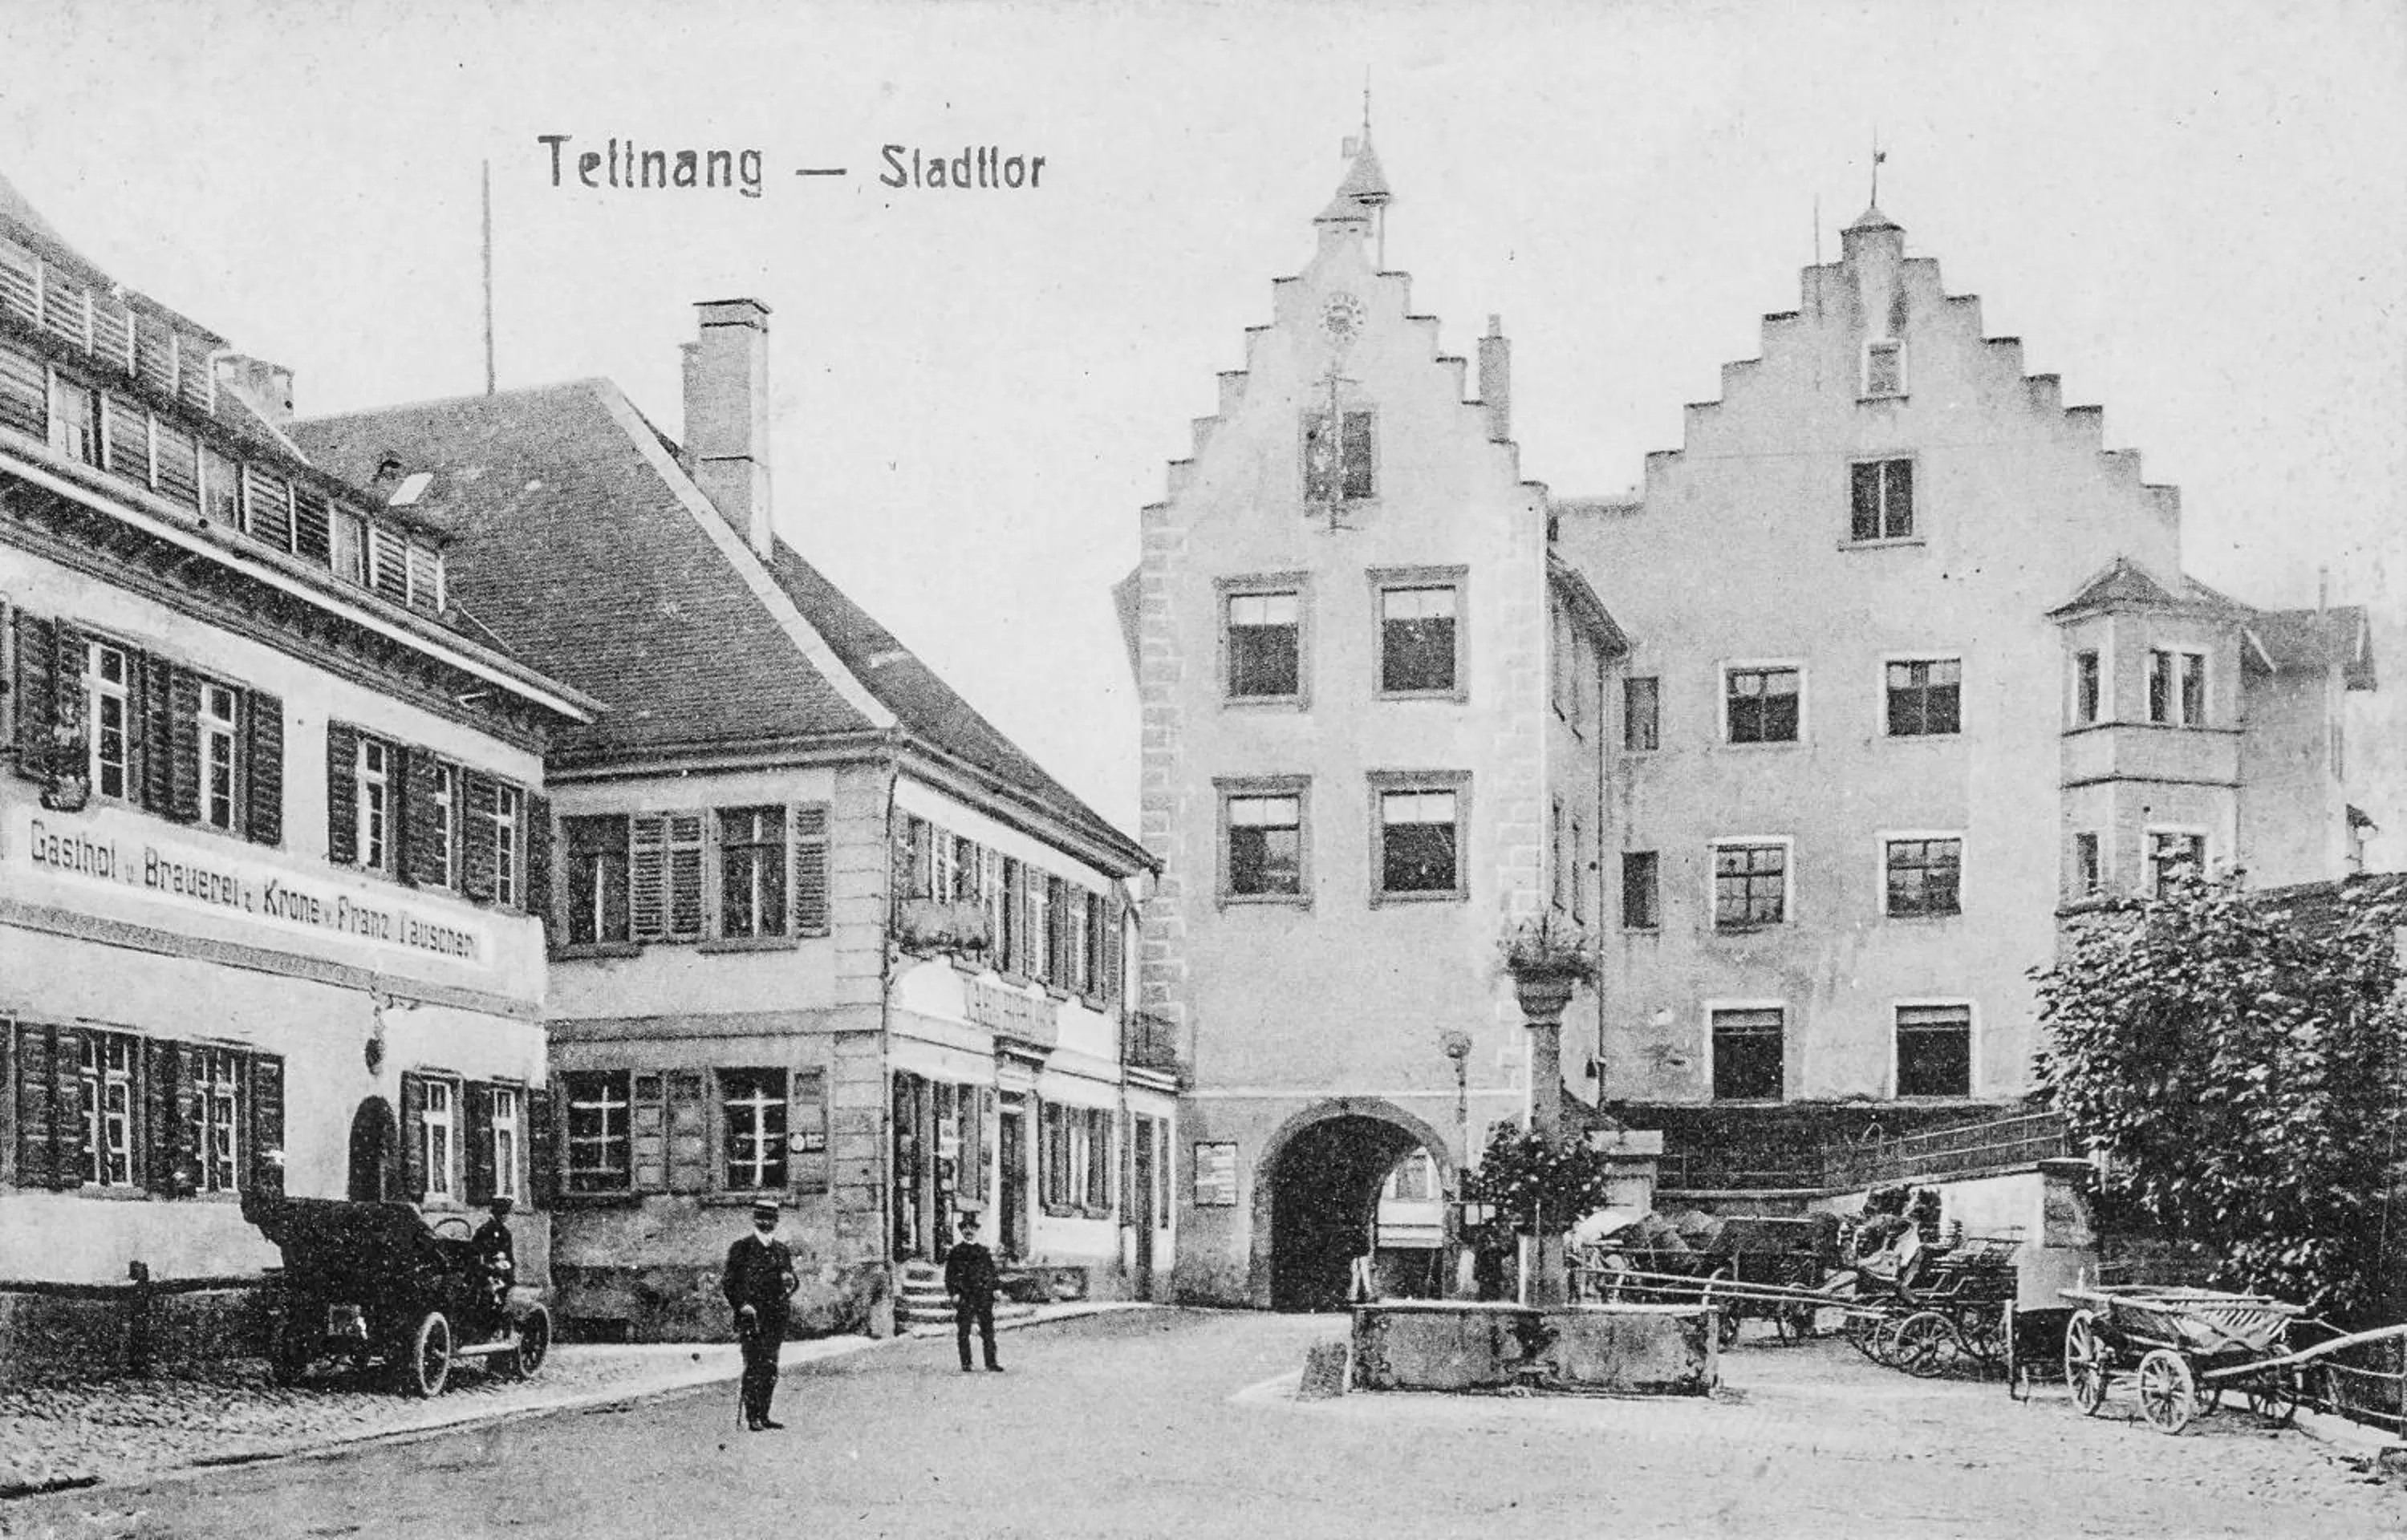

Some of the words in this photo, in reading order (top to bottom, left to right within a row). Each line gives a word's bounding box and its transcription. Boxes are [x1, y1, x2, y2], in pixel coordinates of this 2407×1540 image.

[144, 844, 239, 907] Brauerei
[263, 876, 320, 924] Krone
[337, 894, 390, 940] Franz
